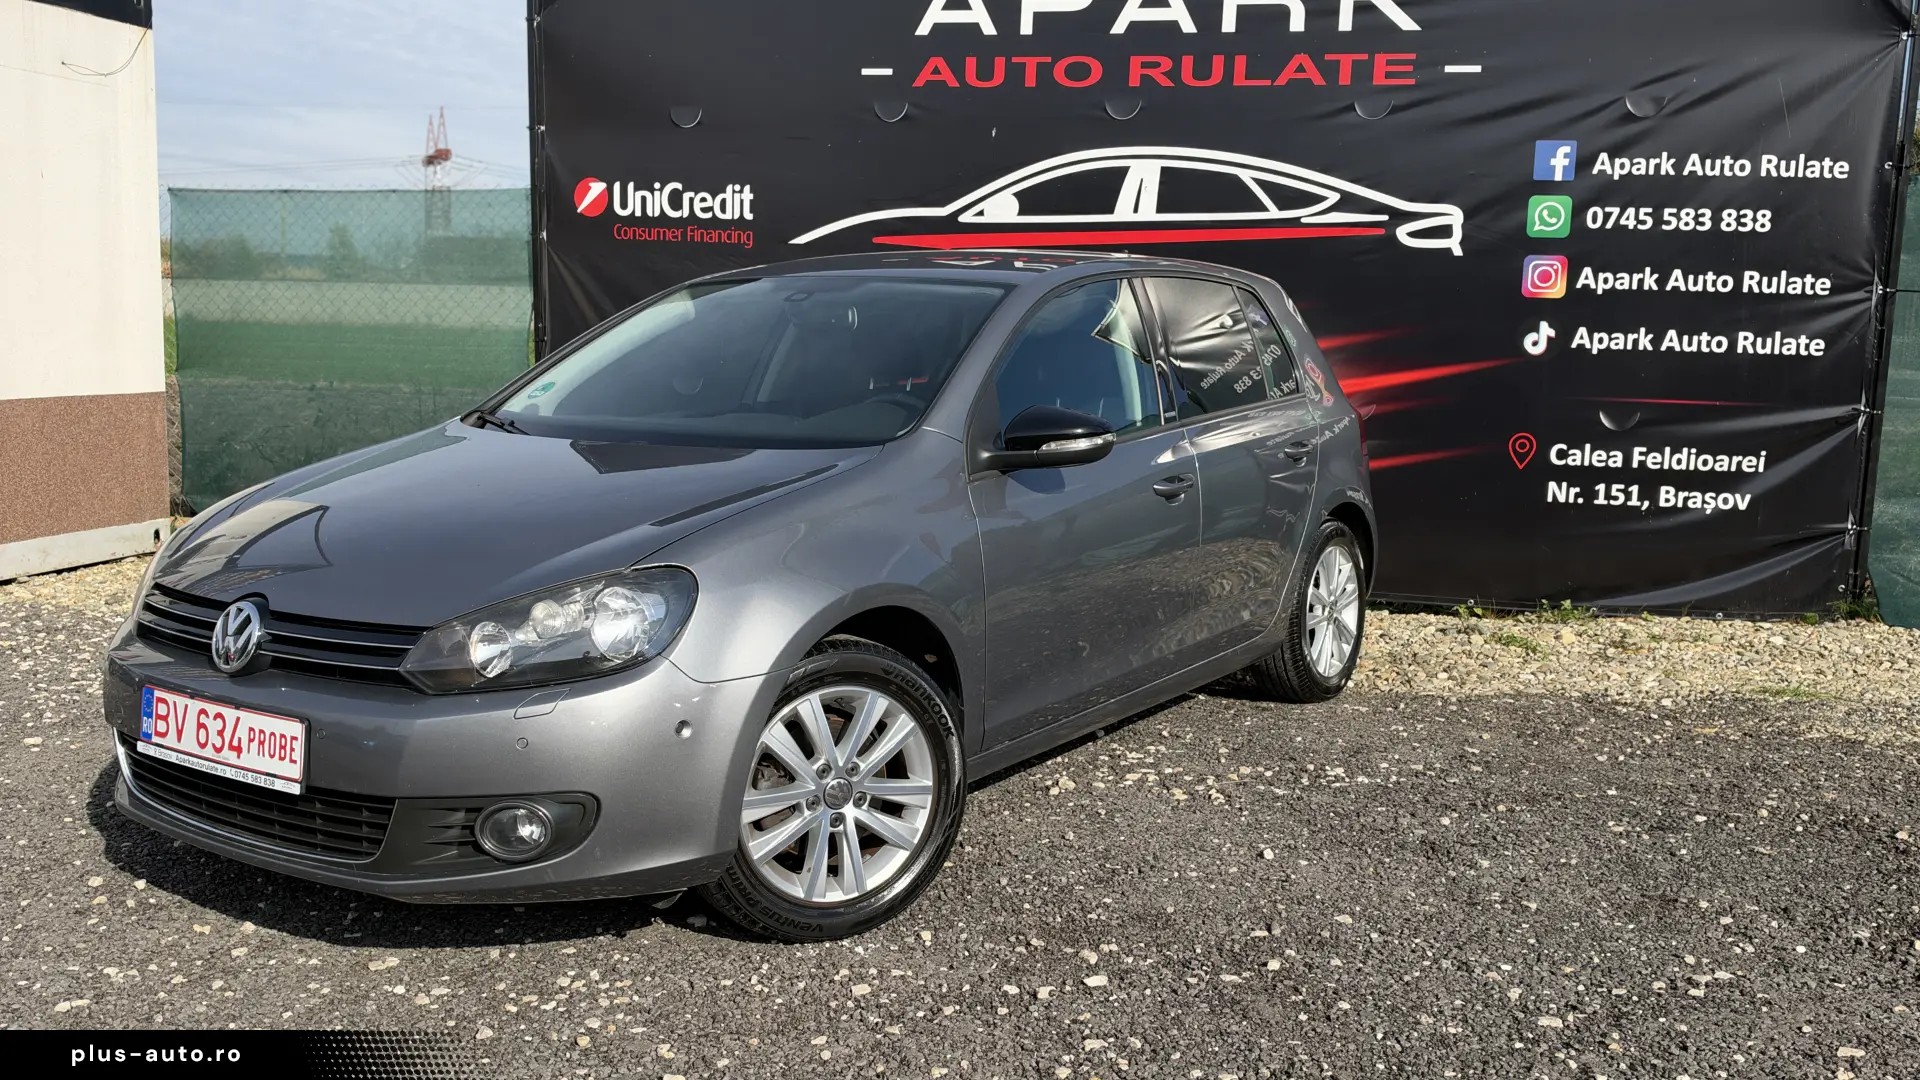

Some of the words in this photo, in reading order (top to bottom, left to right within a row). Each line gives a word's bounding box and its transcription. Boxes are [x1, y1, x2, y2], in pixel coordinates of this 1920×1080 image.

[912, 56, 1104, 88] AUTO
[1129, 52, 1417, 87] RULATE
[1592, 152, 1676, 180] Apark
[1683, 153, 1752, 177] Auto
[1760, 154, 1850, 179] Rulate
[613, 181, 754, 220] UniCredit
[1586, 207, 1654, 231] 0745
[1662, 208, 1712, 232] 583
[1720, 209, 1772, 233] 838
[613, 224, 684, 242] Consumer
[687, 225, 754, 248] Financing
[1576, 267, 1659, 295] Apark
[1666, 269, 1734, 293] Auto
[1742, 271, 1832, 296] Rulate
[1571, 327, 1654, 355] Apark
[1661, 330, 1729, 354] Auto
[1737, 331, 1826, 357] Rulate
[1549, 444, 1623, 468] Calea
[1632, 446, 1767, 473] Feldioarei
[1546, 482, 1584, 504] Nr.
[1593, 484, 1650, 511] 151,
[1658, 486, 1752, 515] Brașov
[142, 716, 153, 734] RO
[154, 695, 189, 744] BV
[196, 707, 243, 760] 634
[247, 726, 299, 765] PROBE
[234, 770, 250, 783] 0745
[250, 774, 262, 785] 583
[263, 777, 276, 788] 838
